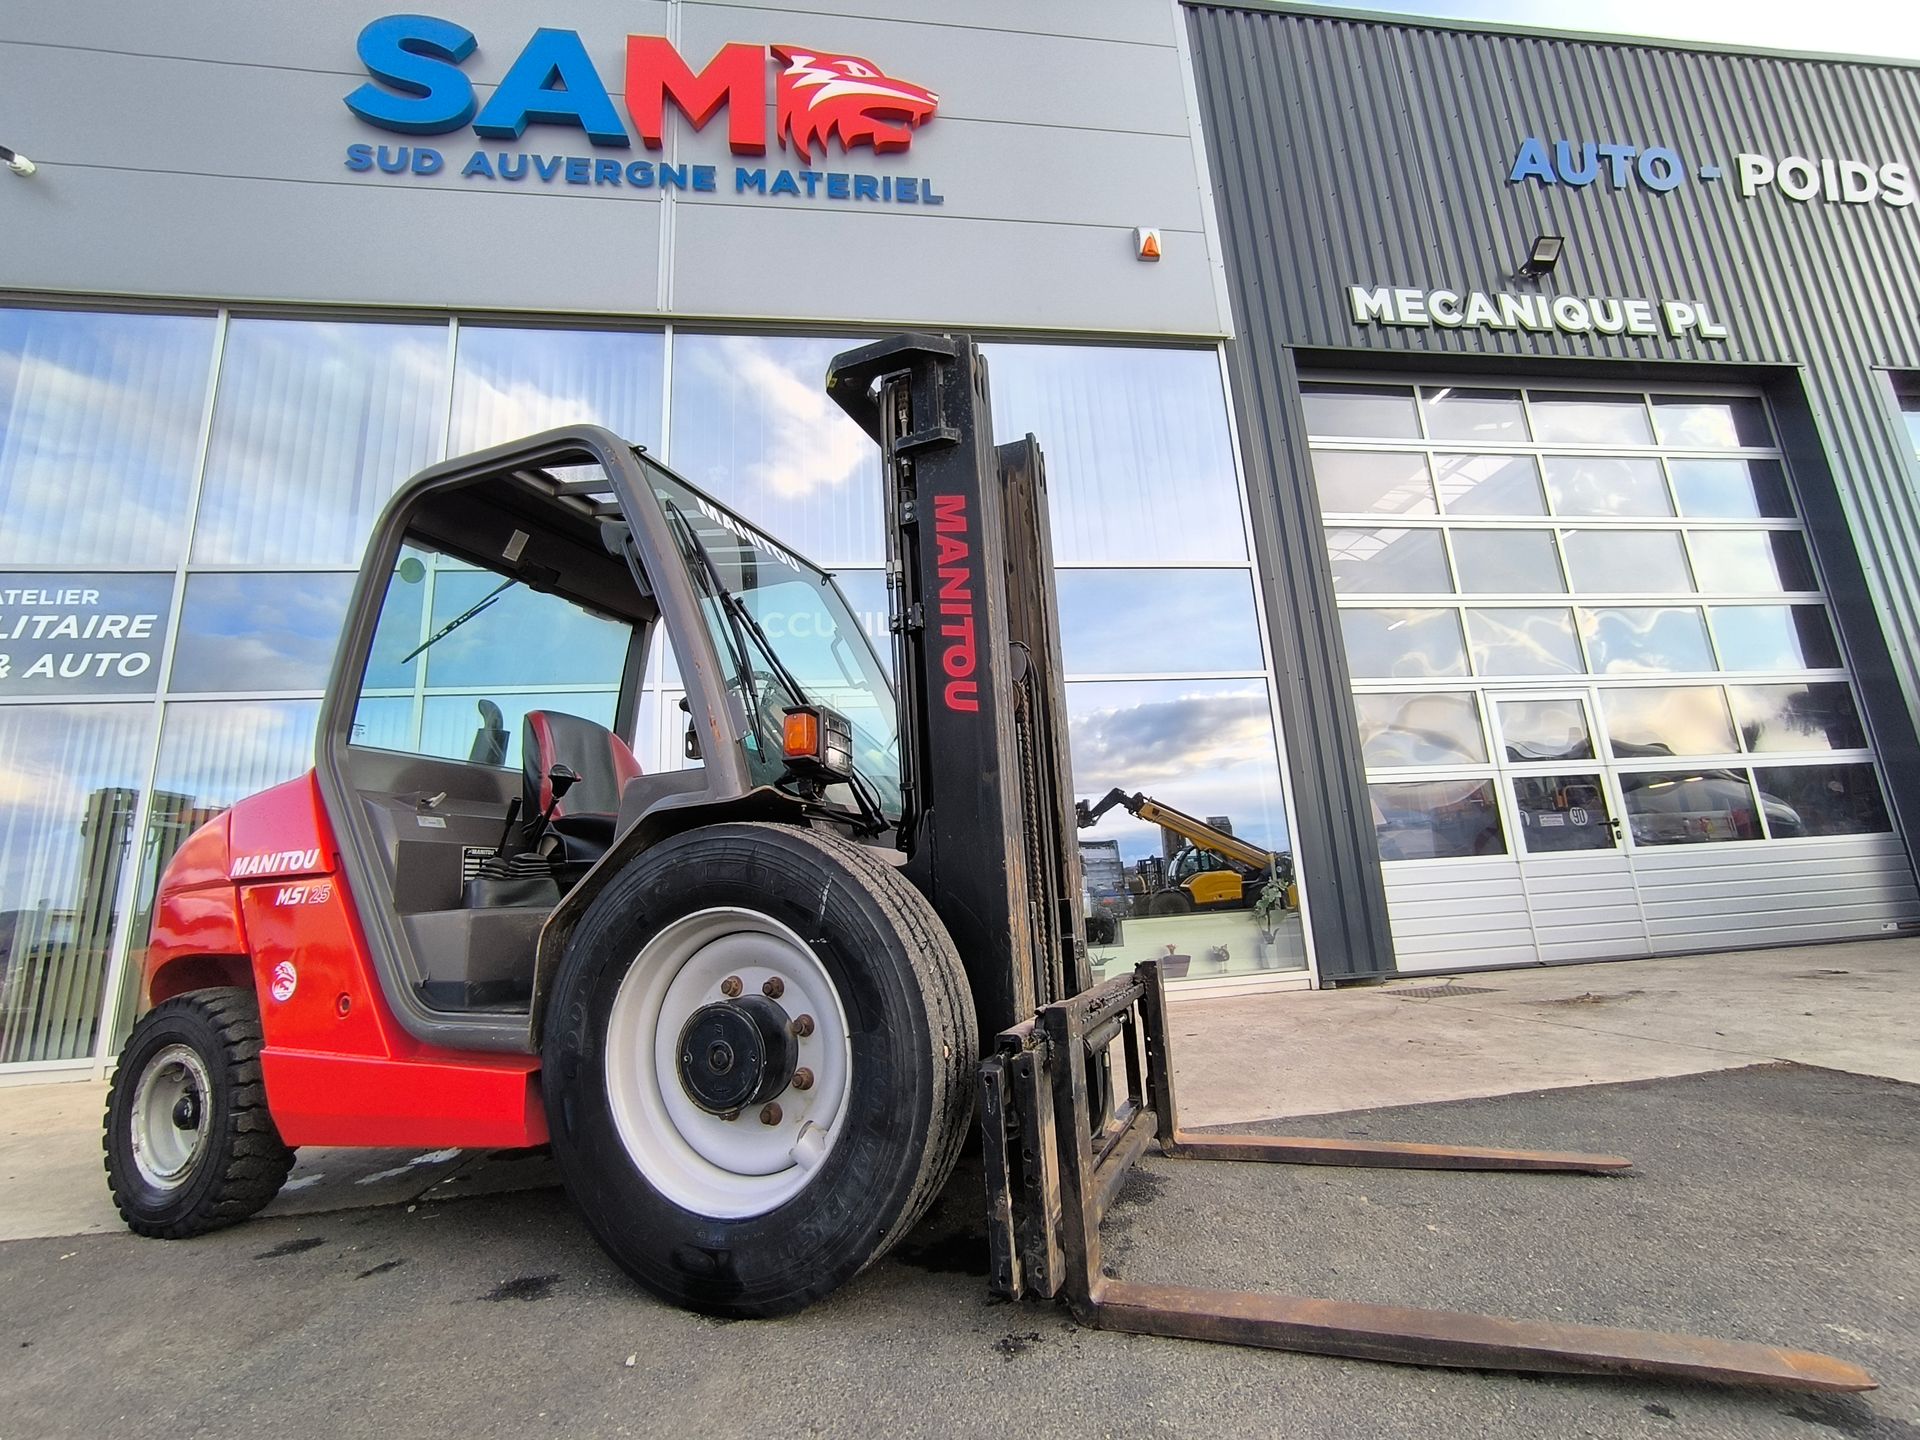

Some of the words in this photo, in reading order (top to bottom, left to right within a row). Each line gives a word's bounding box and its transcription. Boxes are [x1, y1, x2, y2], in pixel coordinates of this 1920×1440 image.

[343, 14, 767, 156] SAM
[344, 143, 443, 176] SUD
[462, 150, 717, 192] AUVERGNE
[734, 166, 945, 205] MATERIEL
[1509, 137, 1685, 193] AUTO
[1738, 153, 1915, 207] POIDS
[1349, 284, 1661, 336] MECANIQUE
[1667, 301, 1728, 338] PL
[695, 496, 801, 573] MANITOU
[762, 611, 891, 639] CCUIL
[934, 495, 979, 712] MANITOU
[22, 652, 151, 679] AUTO
[230, 849, 320, 877] MANITOU
[275, 887, 309, 906] MSI
[309, 884, 332, 904] 25
